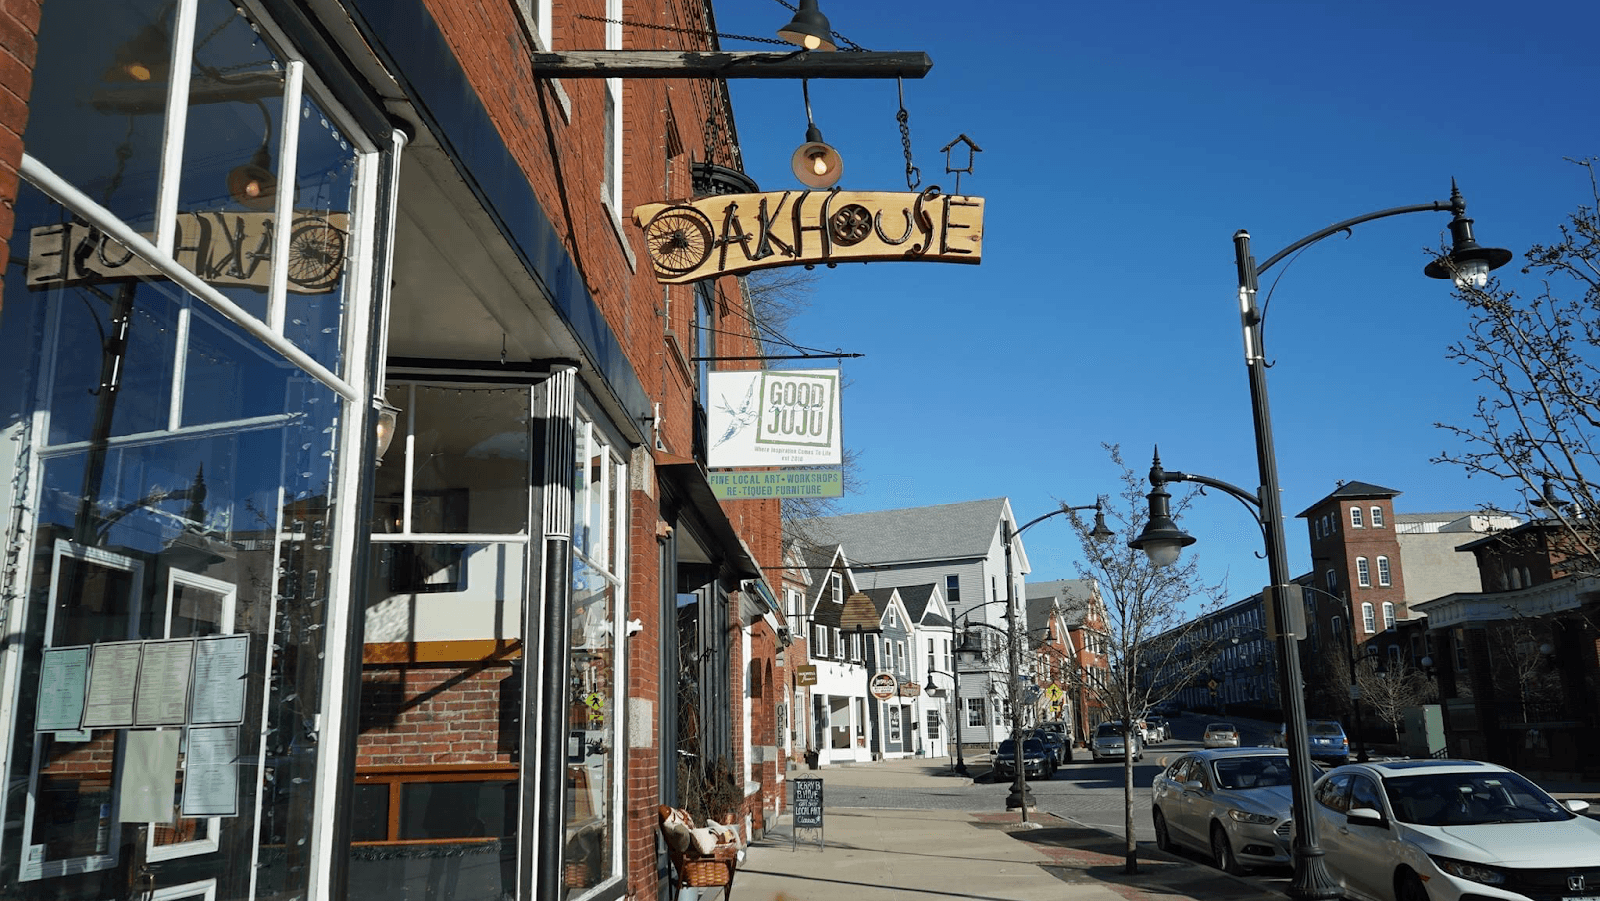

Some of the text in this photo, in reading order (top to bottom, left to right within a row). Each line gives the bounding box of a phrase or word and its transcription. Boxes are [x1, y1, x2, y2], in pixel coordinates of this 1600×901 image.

[645, 186, 980, 277] OAKHOUSE
[770, 381, 825, 407] GOOD
[767, 408, 824, 437] JUJU
[710, 475, 729, 485] FINE
[733, 474, 760, 484] LOCAL
[786, 473, 838, 484] WORKSHOPS
[775, 485, 822, 495] FURNITURE
